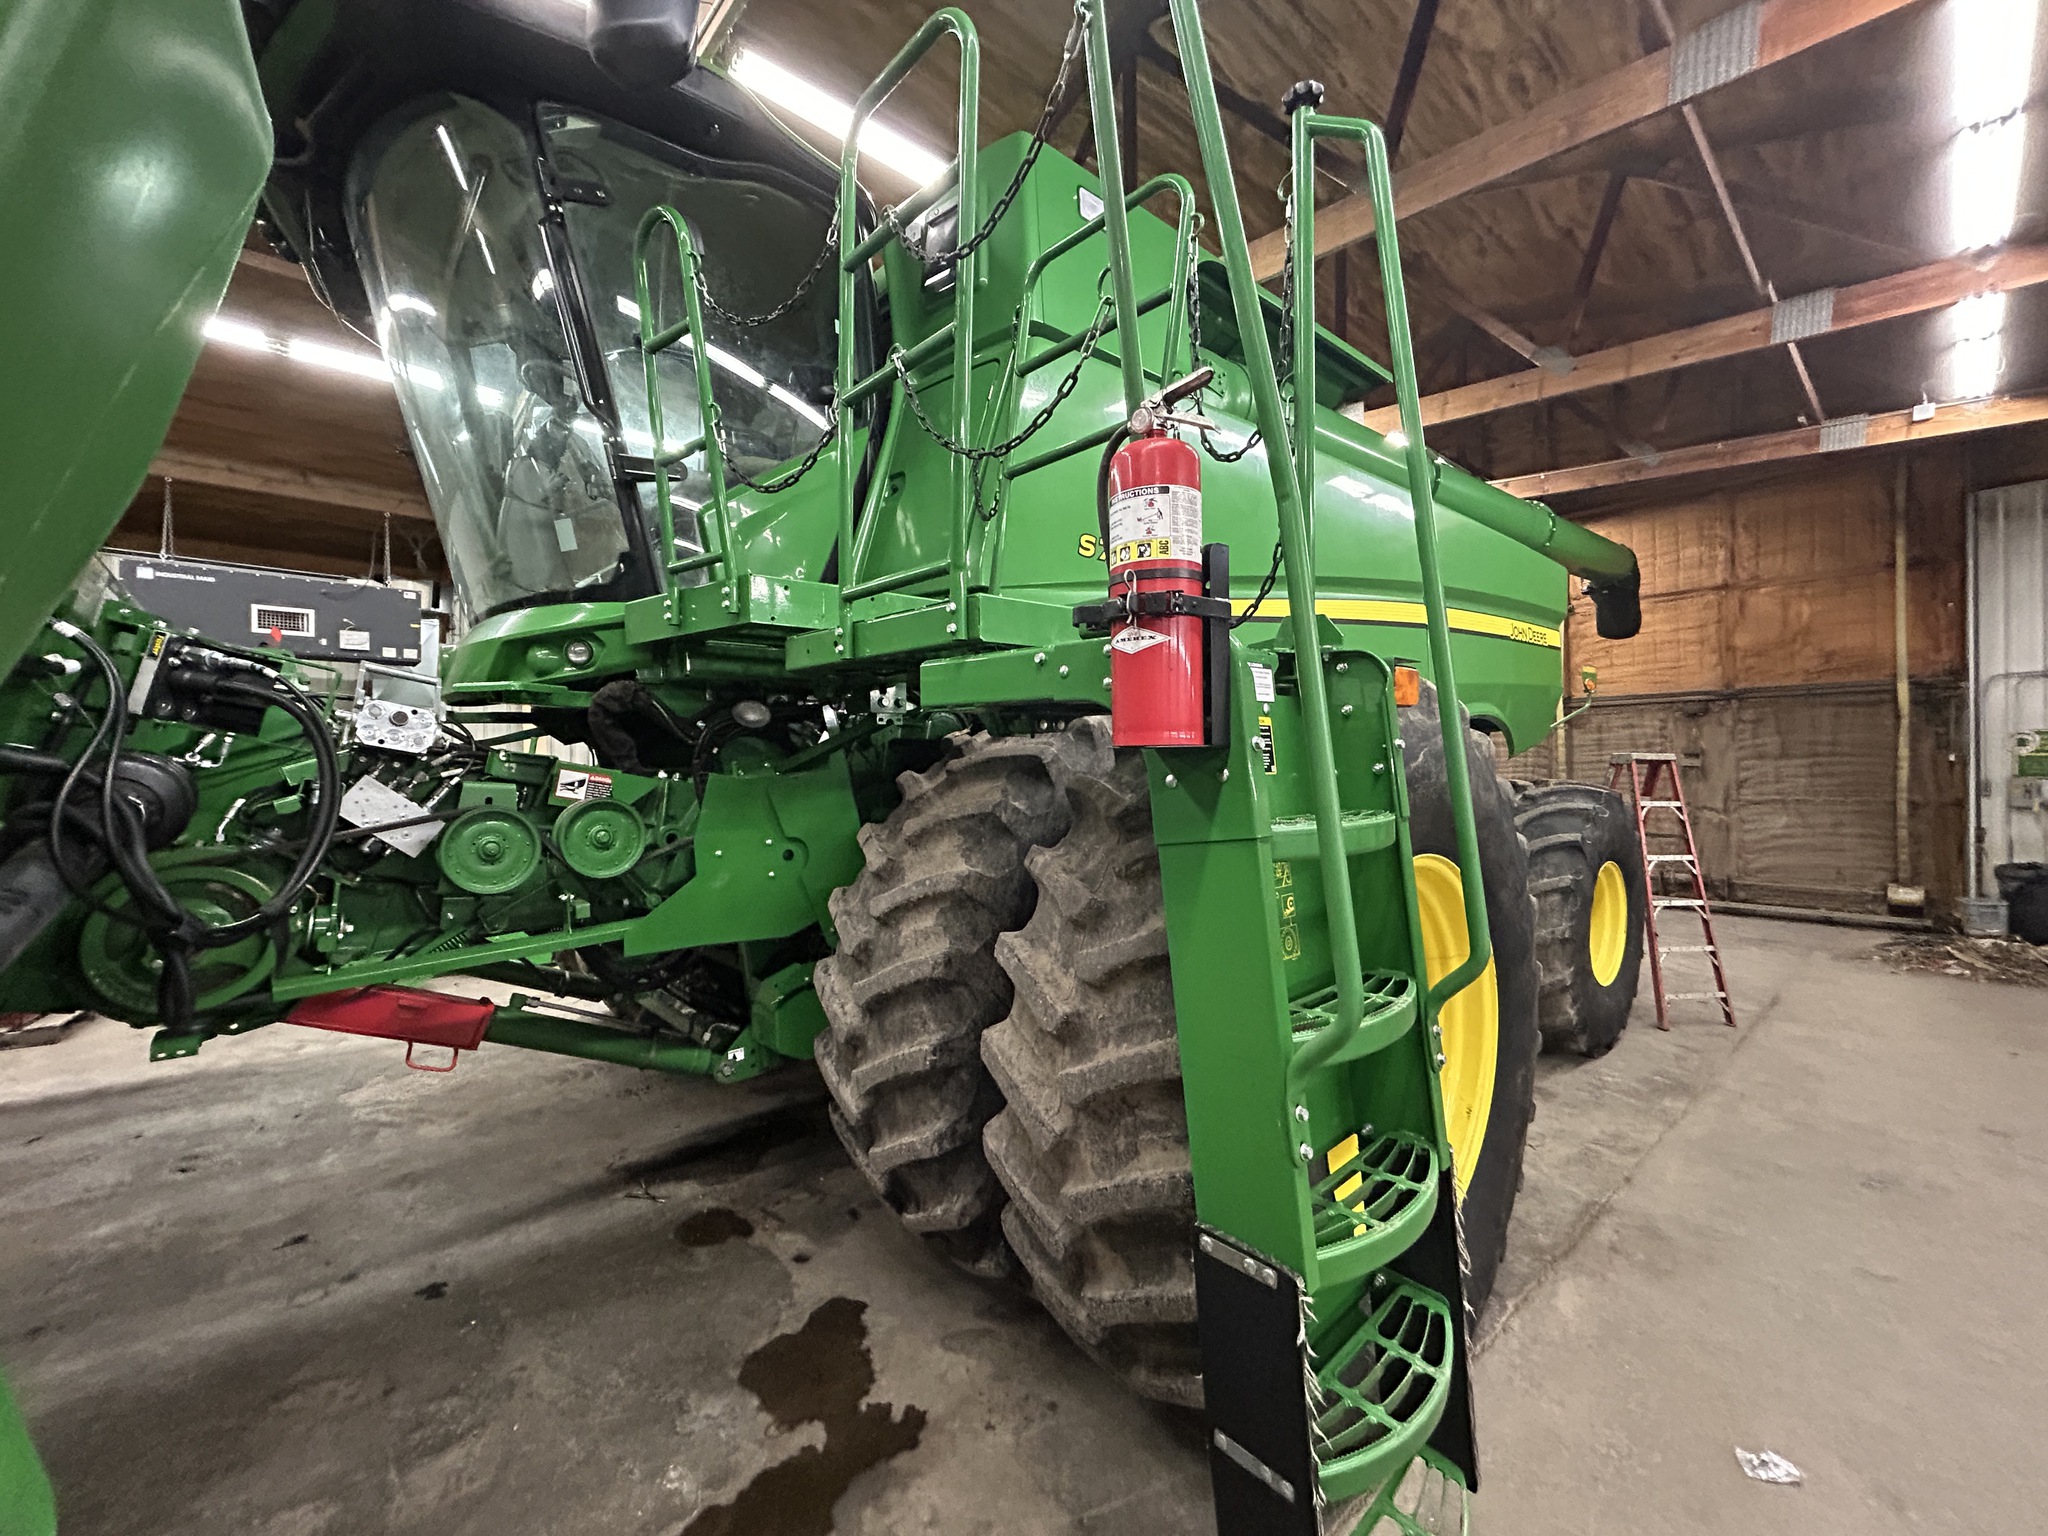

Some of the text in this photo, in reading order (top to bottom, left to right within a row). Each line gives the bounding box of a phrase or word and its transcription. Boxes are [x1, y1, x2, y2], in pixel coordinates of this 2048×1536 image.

[1159, 540, 1169, 555] ABC
[1115, 635, 1157, 644] AMEREX
[1510, 622, 1548, 645] JOHN DEERE
